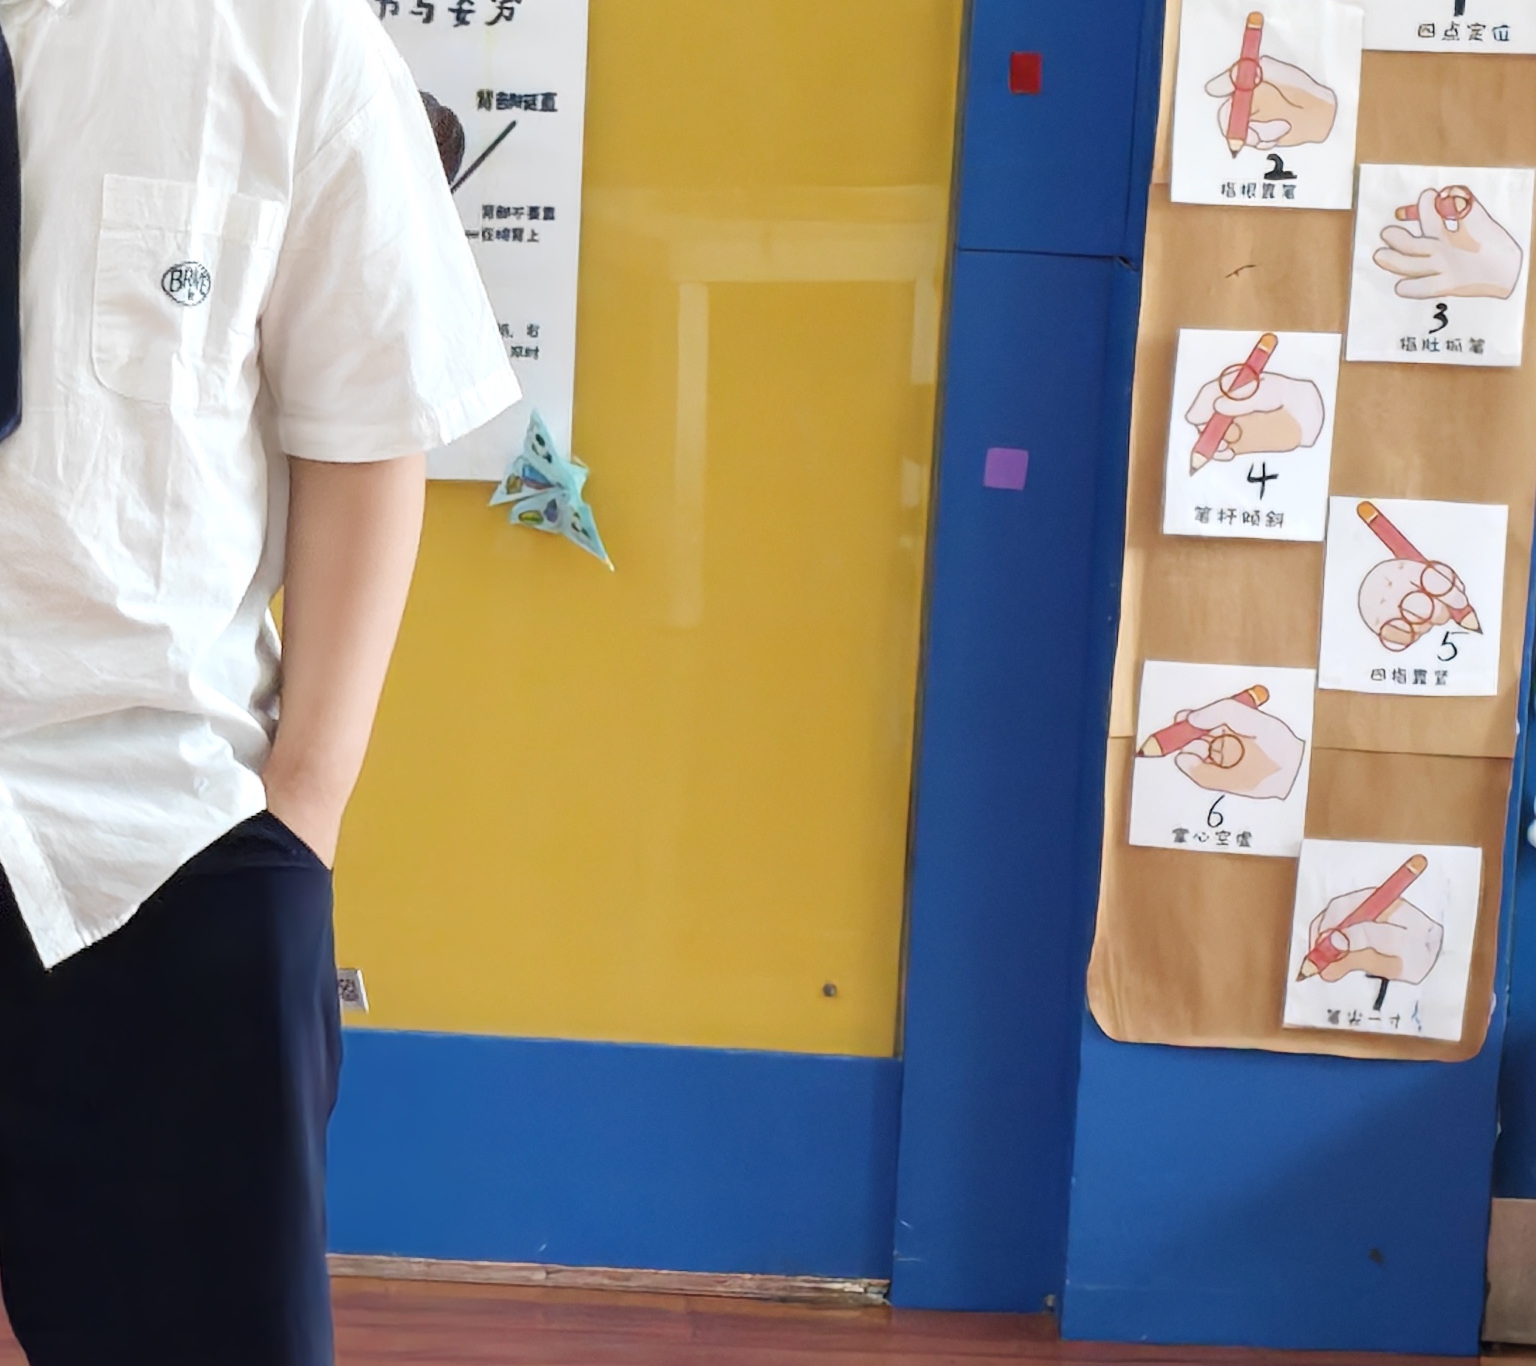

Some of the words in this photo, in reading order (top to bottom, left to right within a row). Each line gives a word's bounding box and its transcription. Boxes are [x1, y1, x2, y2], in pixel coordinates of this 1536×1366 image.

[1418, 21, 1510, 42] 四点定位
[1264, 153, 1298, 181] 2
[1428, 302, 1449, 335] 3
[1246, 461, 1279, 501] 4
[1436, 630, 1470, 662] 5
[1207, 794, 1225, 828] 6
[1365, 973, 1390, 1011] 7
